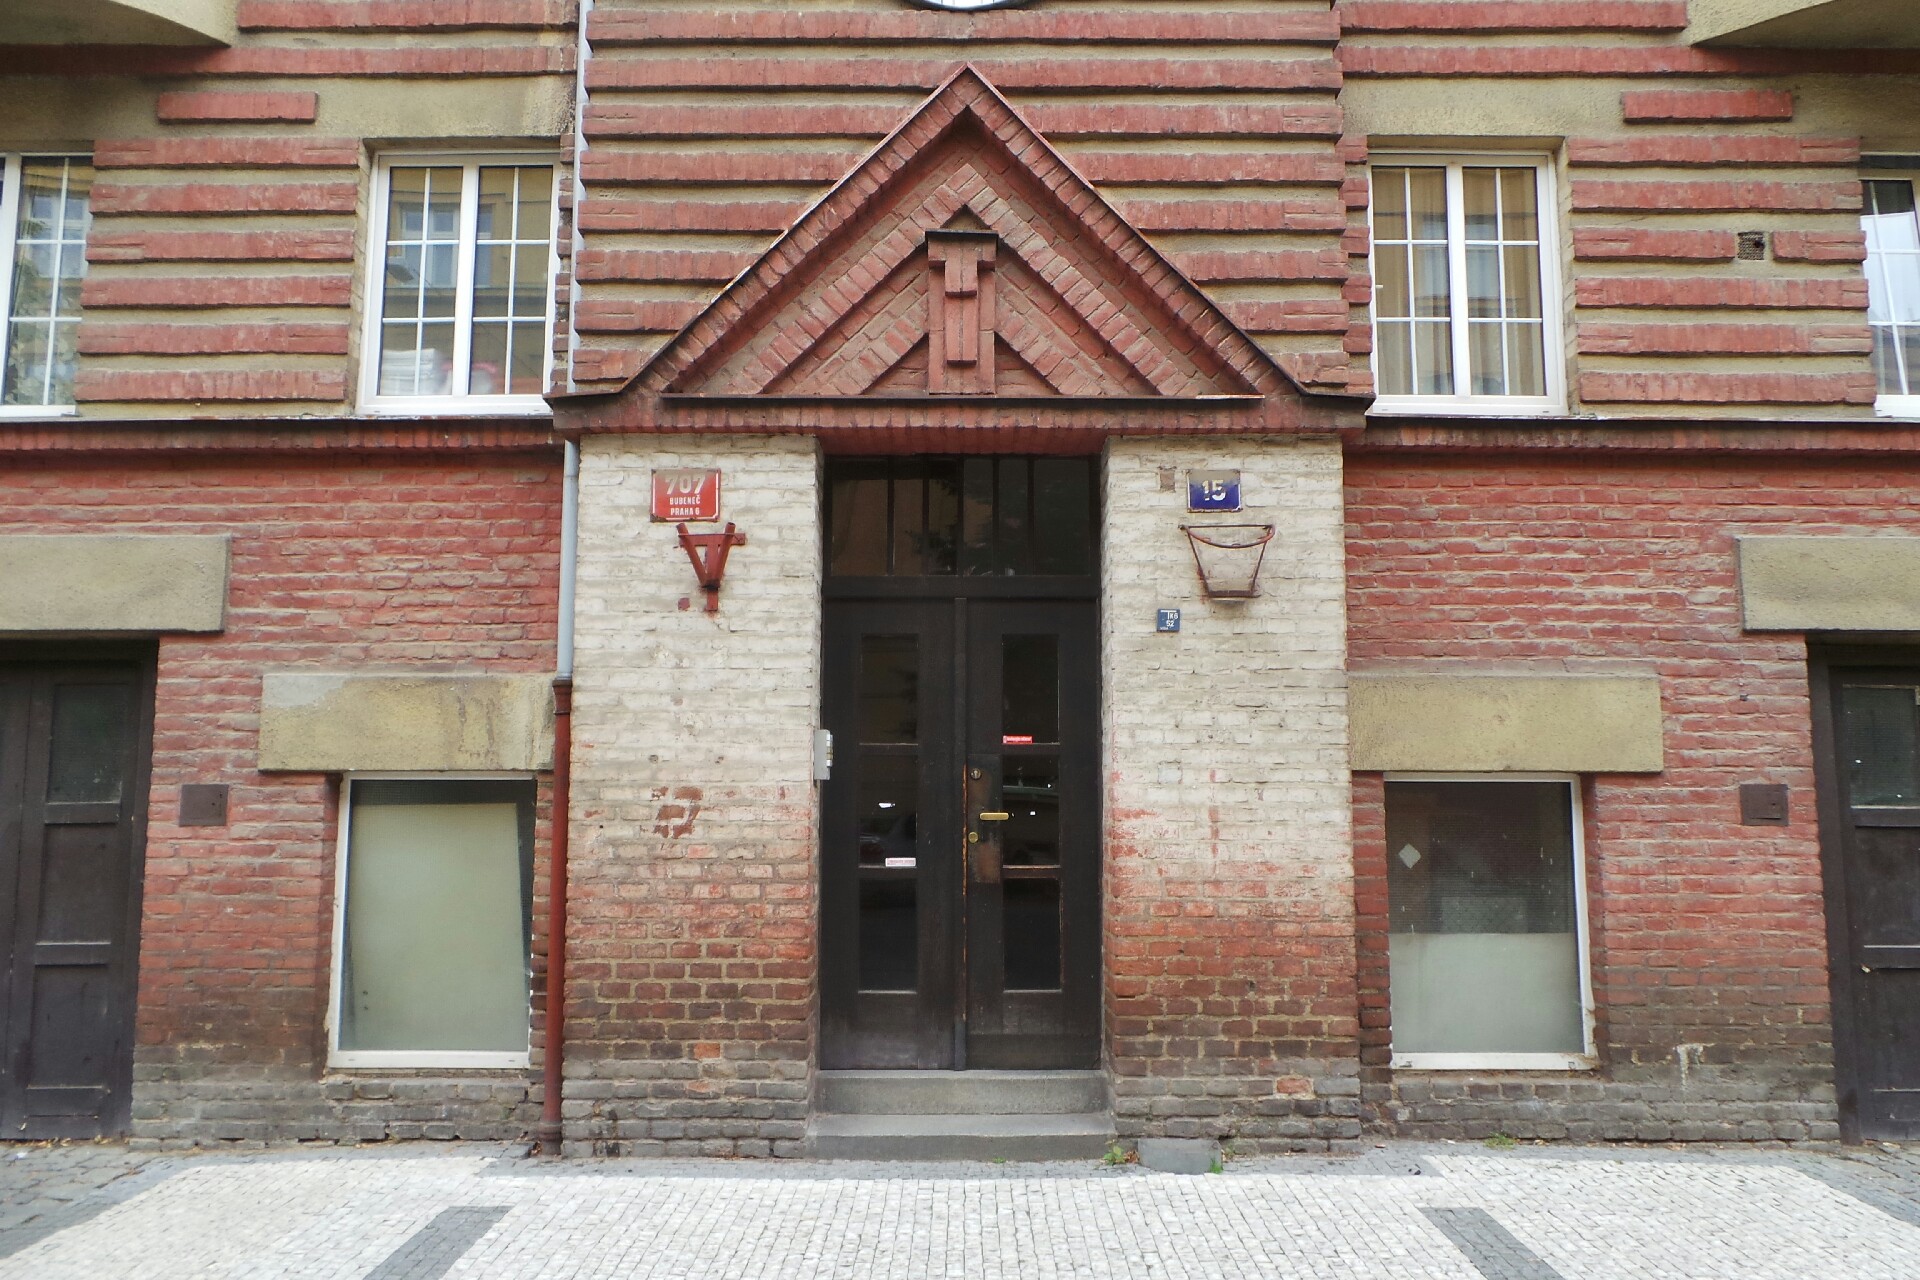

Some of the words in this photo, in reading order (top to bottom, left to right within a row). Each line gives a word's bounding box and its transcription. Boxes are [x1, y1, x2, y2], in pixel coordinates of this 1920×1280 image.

[665, 474, 706, 495] 707
[1202, 479, 1226, 501] 15
[670, 507, 694, 516] PRAHA
[695, 507, 700, 516] 6
